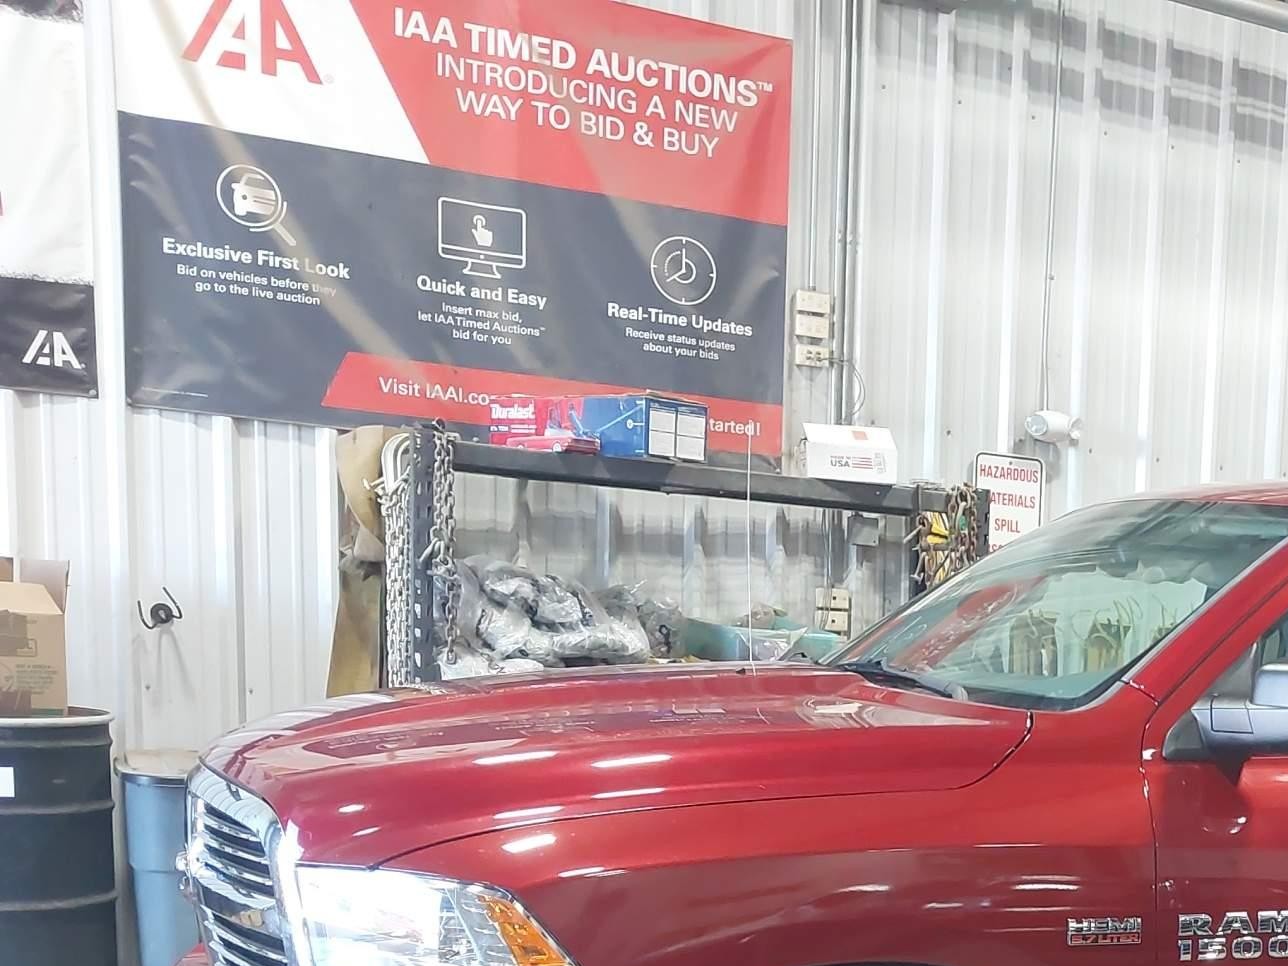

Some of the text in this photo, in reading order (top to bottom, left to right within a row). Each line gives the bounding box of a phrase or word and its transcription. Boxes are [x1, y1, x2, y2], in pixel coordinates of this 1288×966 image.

[394, 7, 459, 49] IAA
[463, 22, 576, 70] TIMED
[436, 52, 738, 133] INTRODUCING A NEW
[455, 88, 720, 158] WAY TO BID & BUY
[162, 237, 350, 280] Exclusive First Look
[176, 264, 336, 297] Bid on vehicles before they
[195, 282, 321, 305] go to the live auction
[416, 274, 548, 310] Quick and Easy
[417, 311, 432, 322] let
[434, 311, 455, 326] IAA
[455, 316, 490, 331] Timed
[442, 302, 522, 323] Insert max bid,
[607, 302, 753, 337] Real-Time Updates
[452, 329, 512, 346] bid for you
[625, 327, 736, 351] Receive status updates
[643, 342, 720, 360] about your bids
[378, 376, 760, 436] Visit IAAI.co tarted!
[490, 400, 536, 419] Duralast
[829, 459, 851, 468] USA
[979, 463, 1039, 483] HAZARDOUS
[988, 491, 1036, 509] ATERIALS
[994, 518, 1021, 534] SPILL
[1067, 917, 1142, 934] HEMI
[1098, 933, 1138, 944] LITER
